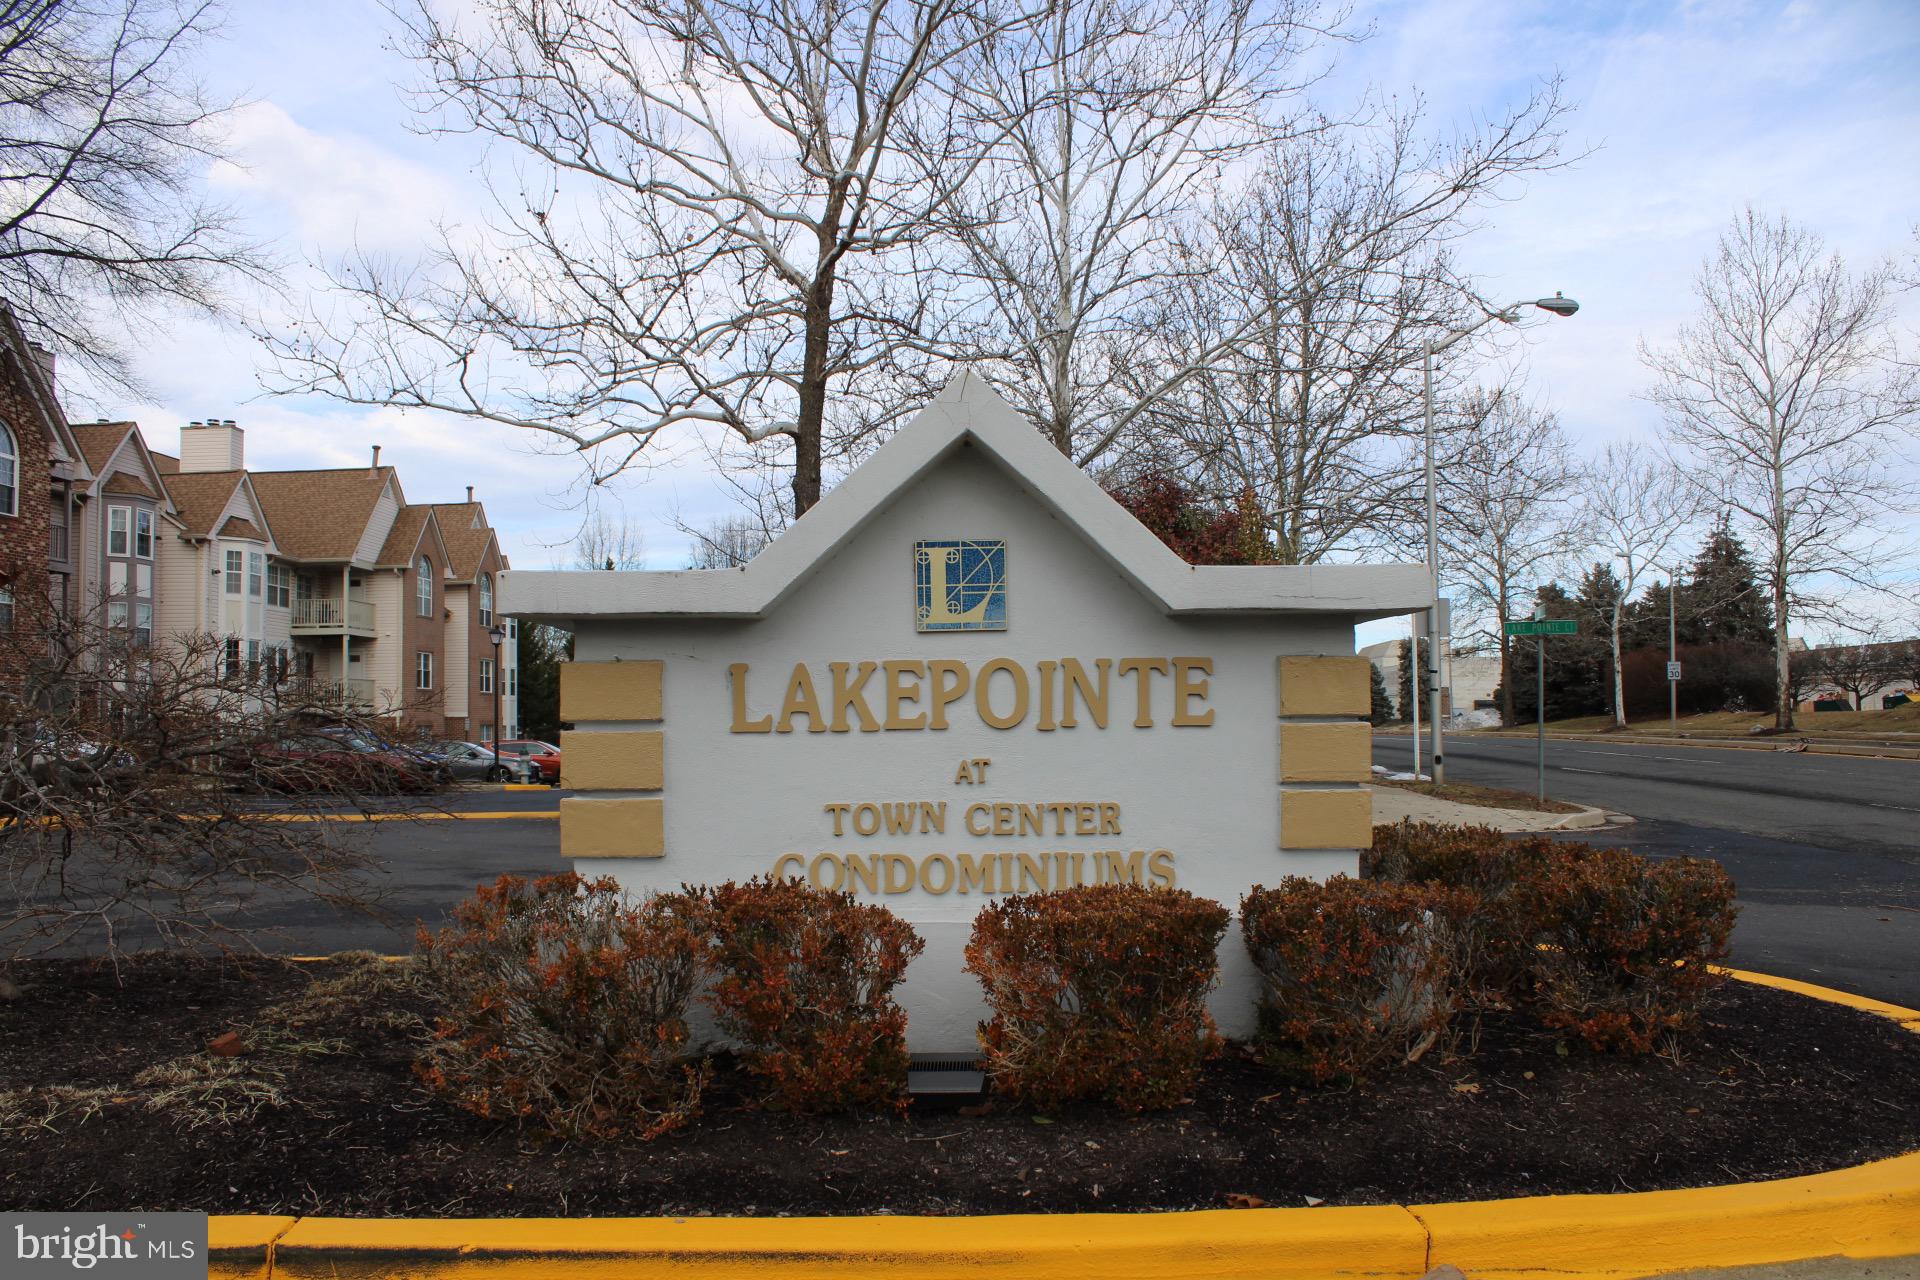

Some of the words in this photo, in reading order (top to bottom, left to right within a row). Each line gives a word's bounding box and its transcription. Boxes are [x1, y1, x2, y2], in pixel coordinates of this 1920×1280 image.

[1506, 623, 1526, 633] LAKE
[1531, 622, 1560, 632] POINTE
[728, 657, 1216, 734] LAKEPOINTE
[954, 758, 992, 785] AT
[824, 801, 947, 837] TOWN
[964, 802, 1123, 837] CENTER
[772, 849, 1178, 895] CONDOMINIUMS
